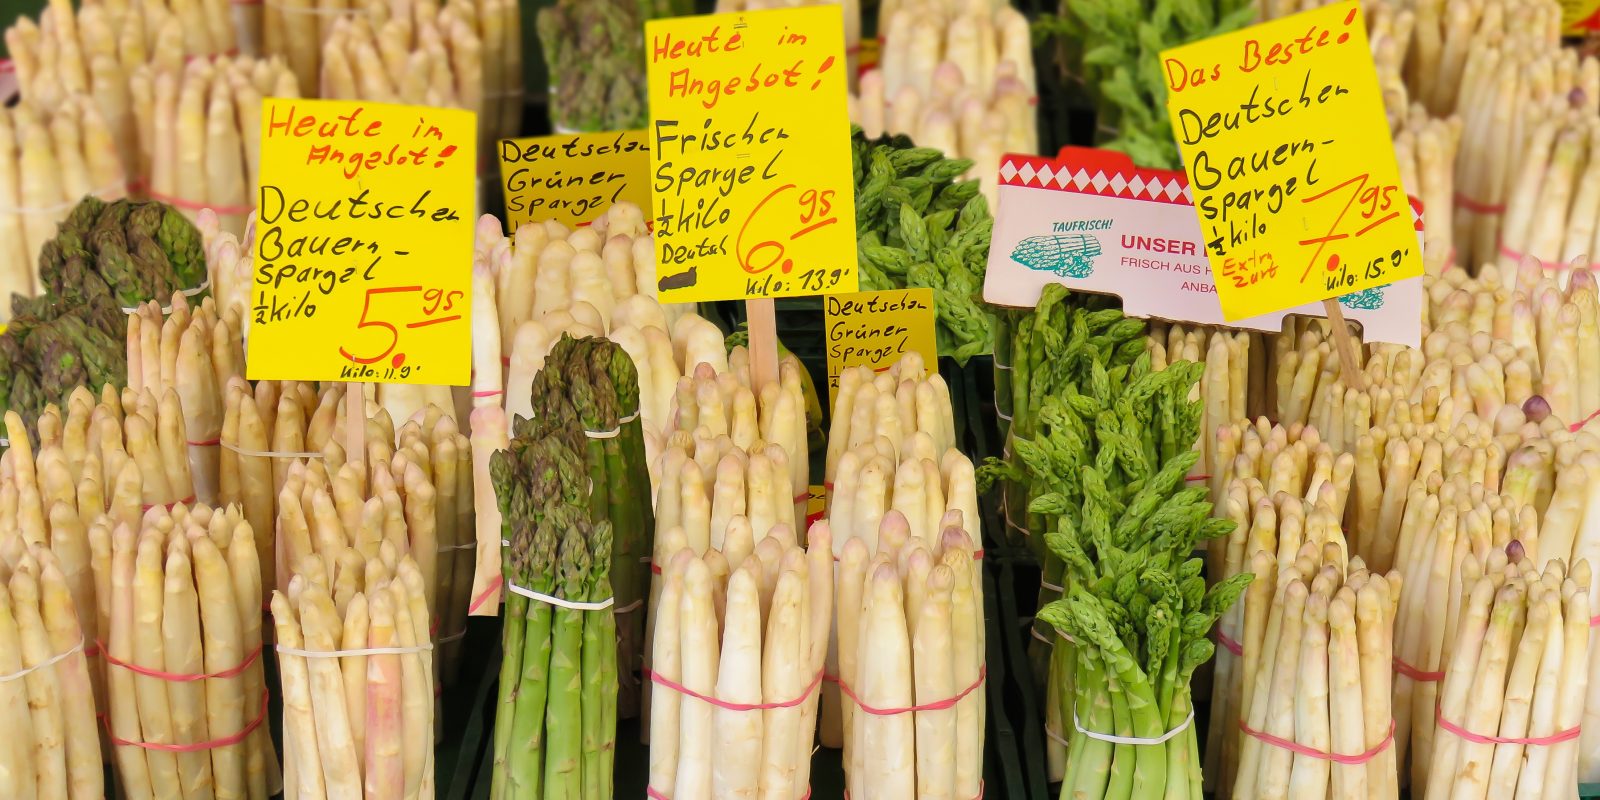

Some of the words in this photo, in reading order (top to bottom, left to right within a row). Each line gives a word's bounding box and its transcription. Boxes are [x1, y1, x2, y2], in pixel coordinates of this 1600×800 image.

[653, 26, 741, 63] Heute
[778, 26, 808, 46] im
[1165, 58, 1221, 92] Das
[1239, 7, 1357, 73] Beste!
[268, 105, 382, 138] Heute
[412, 117, 443, 141] im
[507, 168, 625, 192] Grüner
[654, 149, 784, 196] Spargel
[1052, 218, 1113, 232] TAUFRISCH!
[1121, 234, 1196, 256] UNSER
[1120, 256, 1170, 271] FRISCH
[1173, 263, 1201, 275] AUS
[830, 321, 907, 341] Grüner
[829, 336, 908, 363] Spargel
